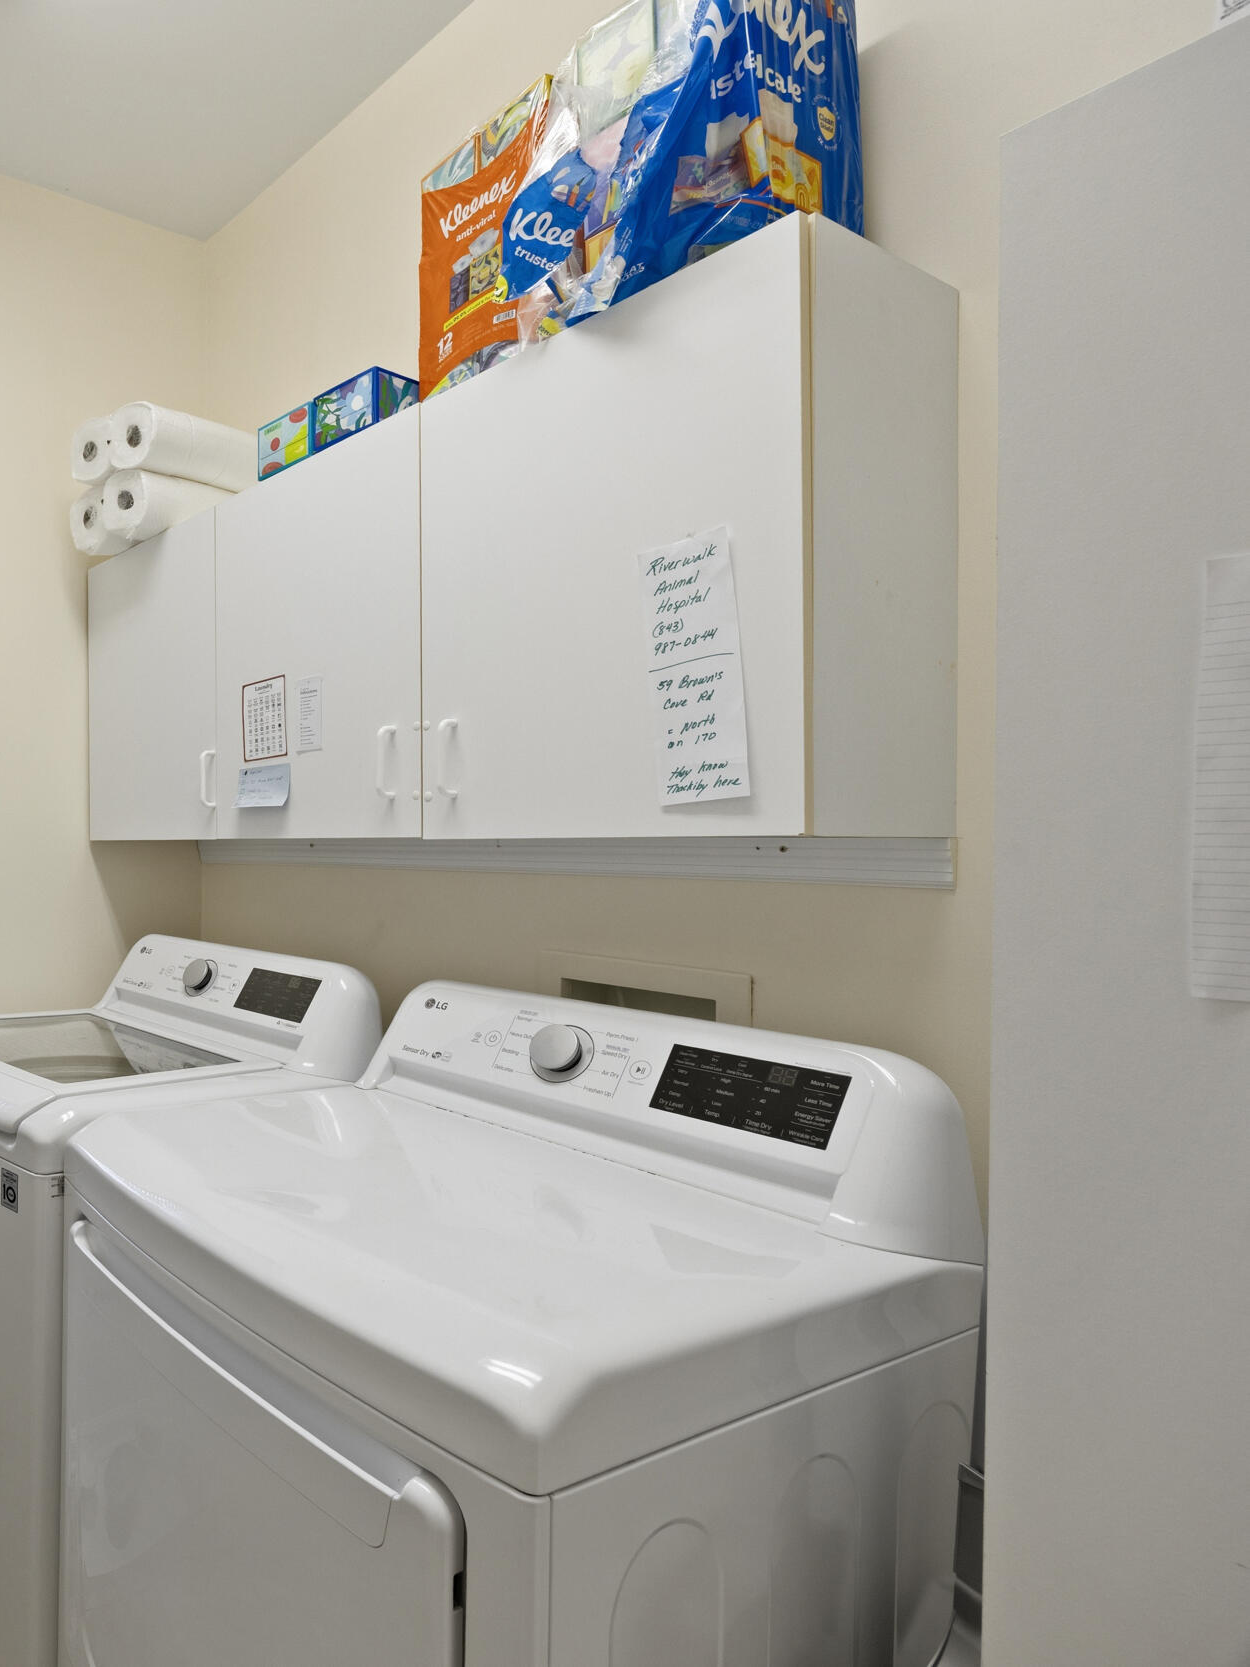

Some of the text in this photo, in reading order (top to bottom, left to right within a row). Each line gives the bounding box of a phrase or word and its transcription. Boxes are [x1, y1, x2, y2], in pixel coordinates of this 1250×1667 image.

[439, 169, 517, 239] Kleenex
[455, 209, 497, 243] anti-viral
[437, 331, 453, 356] 12
[646, 544, 717, 576] Riverwalk
[654, 569, 700, 596] Animal
[656, 587, 711, 615] Hospital
[652, 618, 684, 638] (843)
[654, 628, 718, 656] 987-0844
[657, 670, 724, 691] 59 Brown's
[663, 690, 714, 710] Cove Rd
[680, 714, 715, 735] North
[698, 760, 728, 774] know
[713, 774, 742, 788] here
[435, 1001, 448, 1010] LG
[419, 1048, 429, 1057] Dry
[668, 1100, 684, 1108] Level
[705, 1109, 720, 1118] Temp
[745, 1119, 760, 1127] Time
[760, 1122, 772, 1130] Dry
[794, 1111, 814, 1120] Energy
